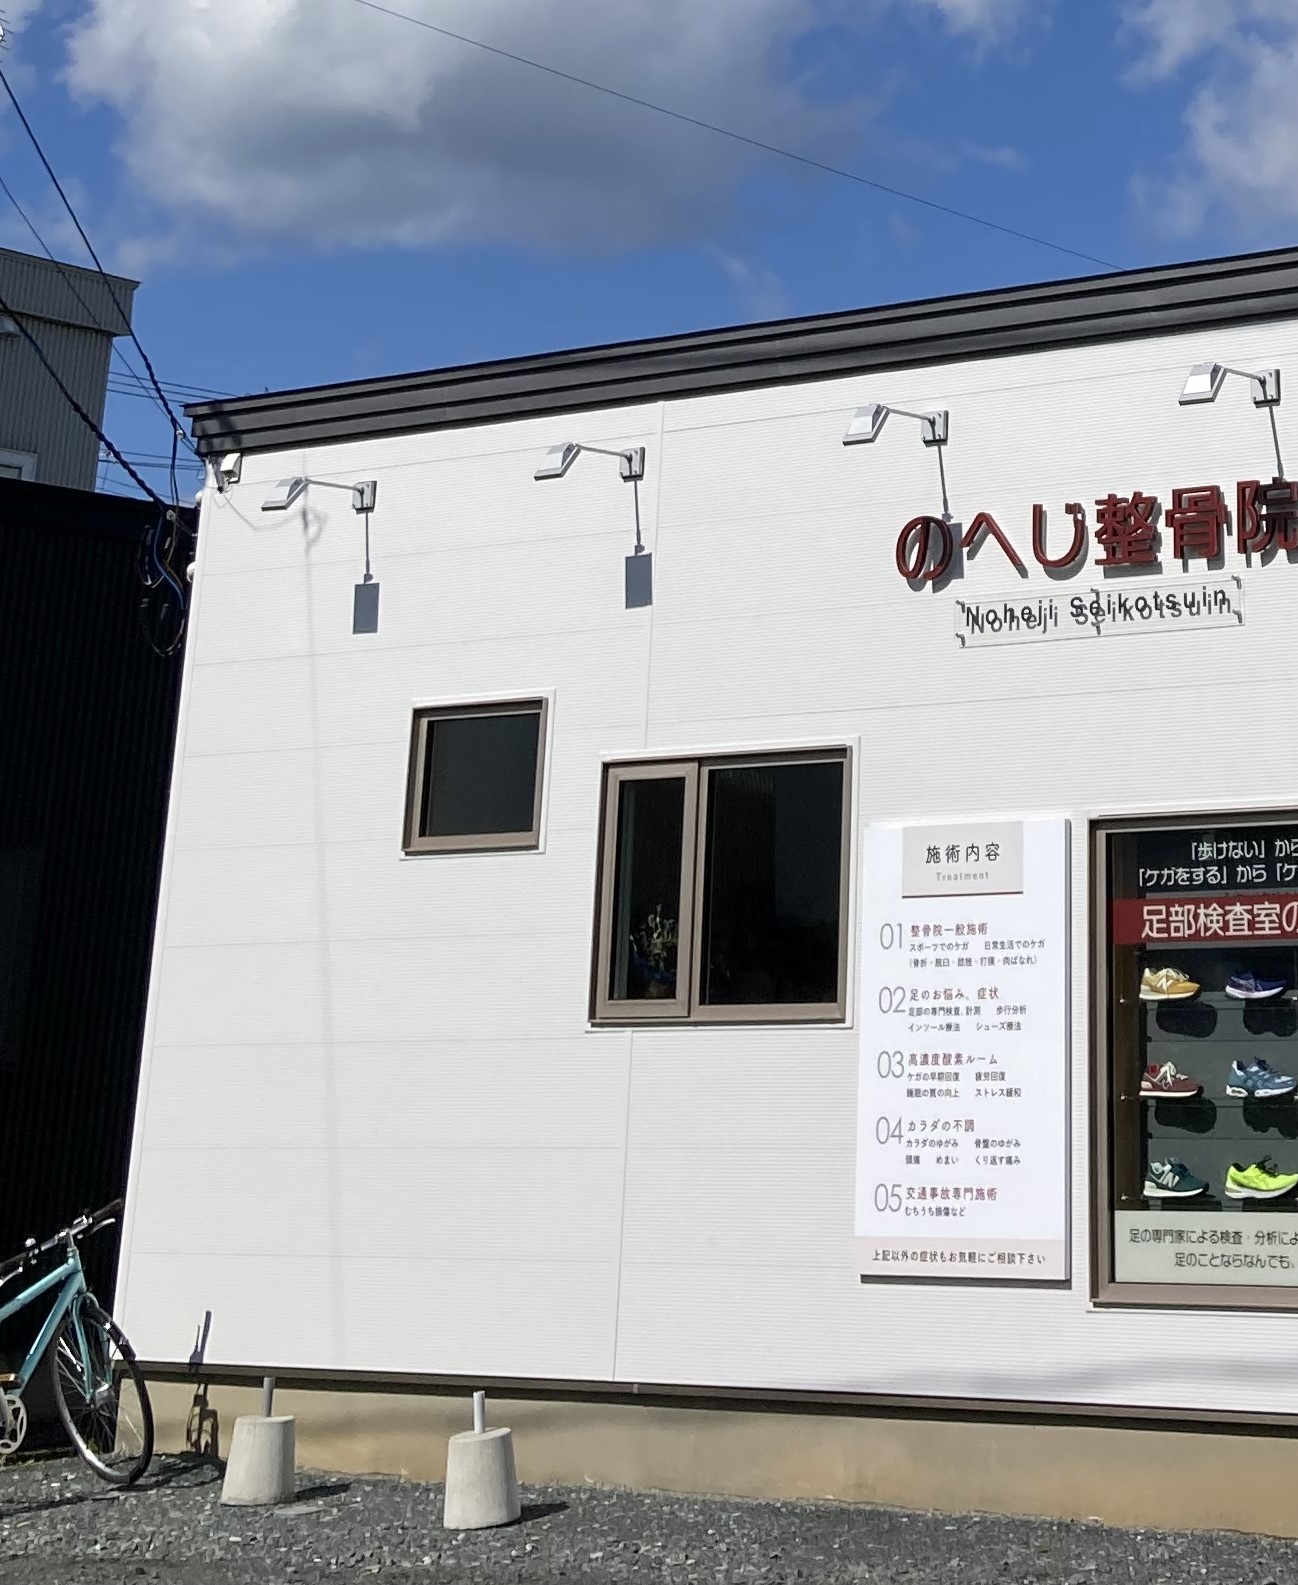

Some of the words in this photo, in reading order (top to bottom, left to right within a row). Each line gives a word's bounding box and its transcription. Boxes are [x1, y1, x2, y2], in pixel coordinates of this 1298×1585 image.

[966, 598, 1054, 629] Noheji
[1070, 586, 1226, 619] Seikotsuin
[925, 842, 1001, 864] 施術内容
[936, 871, 989, 882] Treatment
[879, 922, 903, 949] 01
[910, 922, 988, 937] 整骨院一般施術
[909, 941, 969, 952] スポーツでのケガ
[984, 939, 1045, 951] 日常生活でのケガ
[879, 986, 906, 1014] 02
[996, 1004, 1027, 1015] 歩行分析
[877, 1050, 905, 1079] 03
[908, 1052, 998, 1066] 高濃度酸素ルーム
[876, 1116, 904, 1145] 04
[907, 1119, 975, 1132] カラダの不調
[906, 1138, 959, 1148] カラダのゆがみ
[874, 1183, 902, 1212] 05
[906, 1187, 998, 1201] 交通事故専門施術
